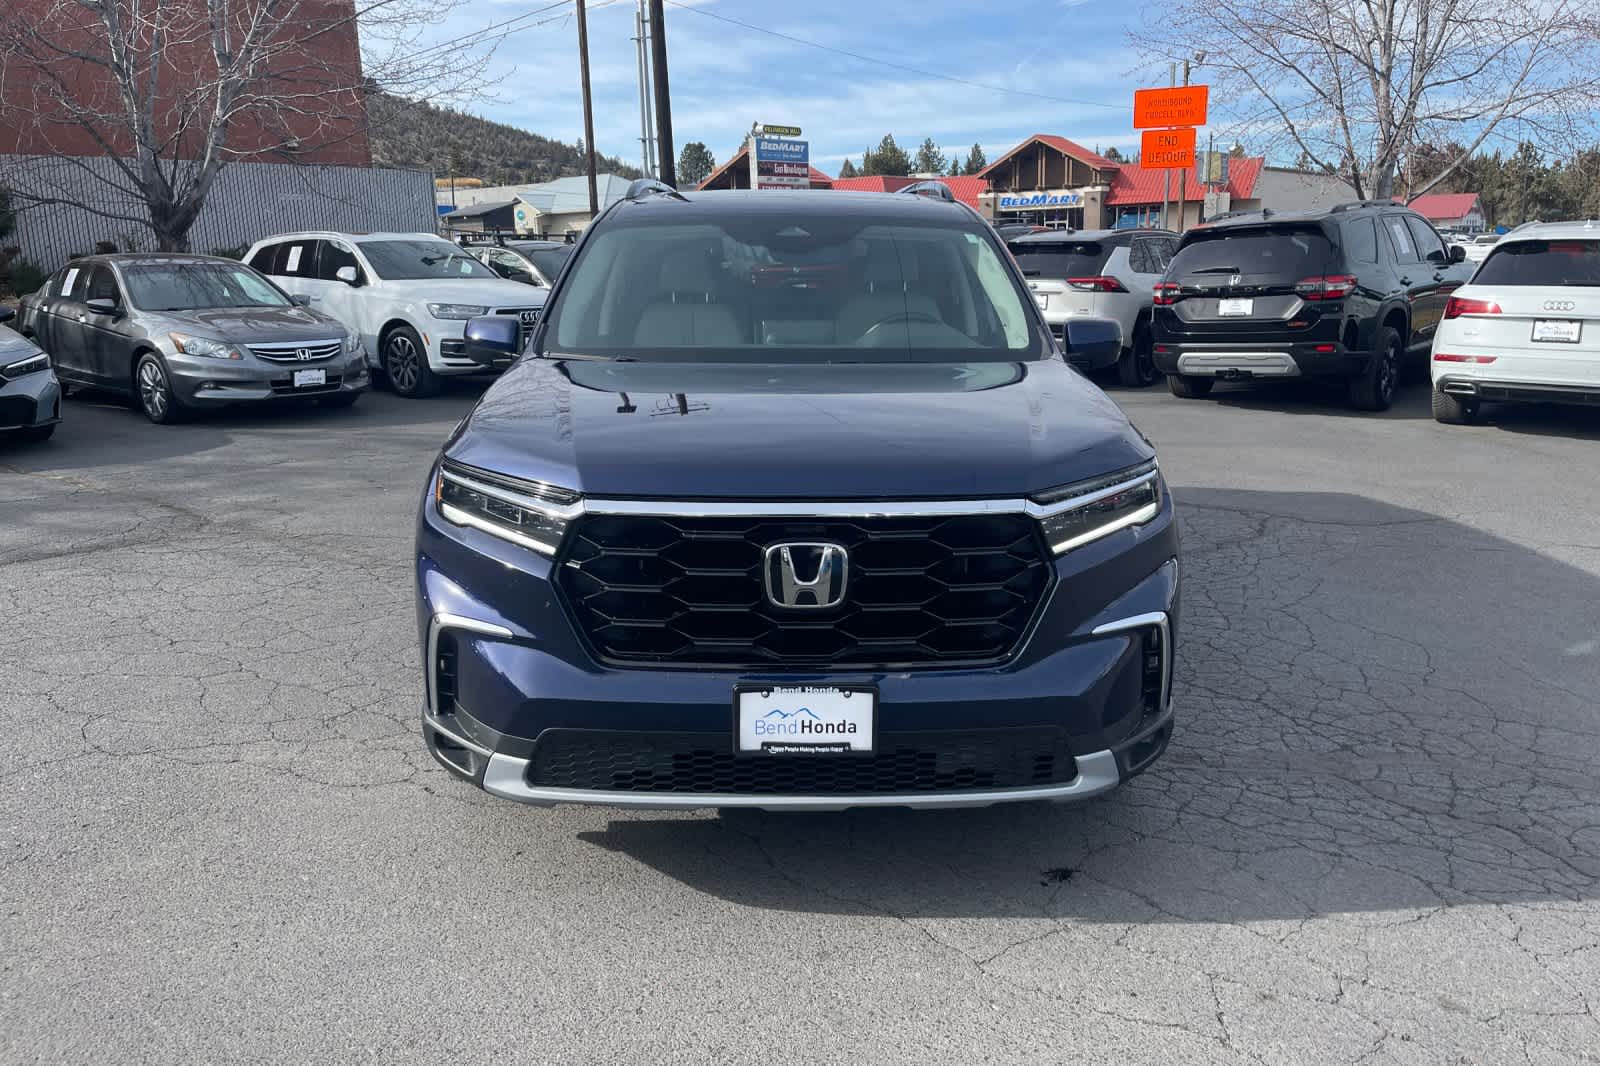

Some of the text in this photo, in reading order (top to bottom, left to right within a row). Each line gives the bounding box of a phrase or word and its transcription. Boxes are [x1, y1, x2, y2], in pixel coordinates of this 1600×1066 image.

[760, 141, 805, 152] BEDMART
[1158, 135, 1178, 147] END
[1148, 152, 1187, 163] DETOUR
[1001, 194, 1079, 206] BEDMART
[773, 686, 840, 694] Bend Honda
[755, 719, 857, 735] Bend Honda
